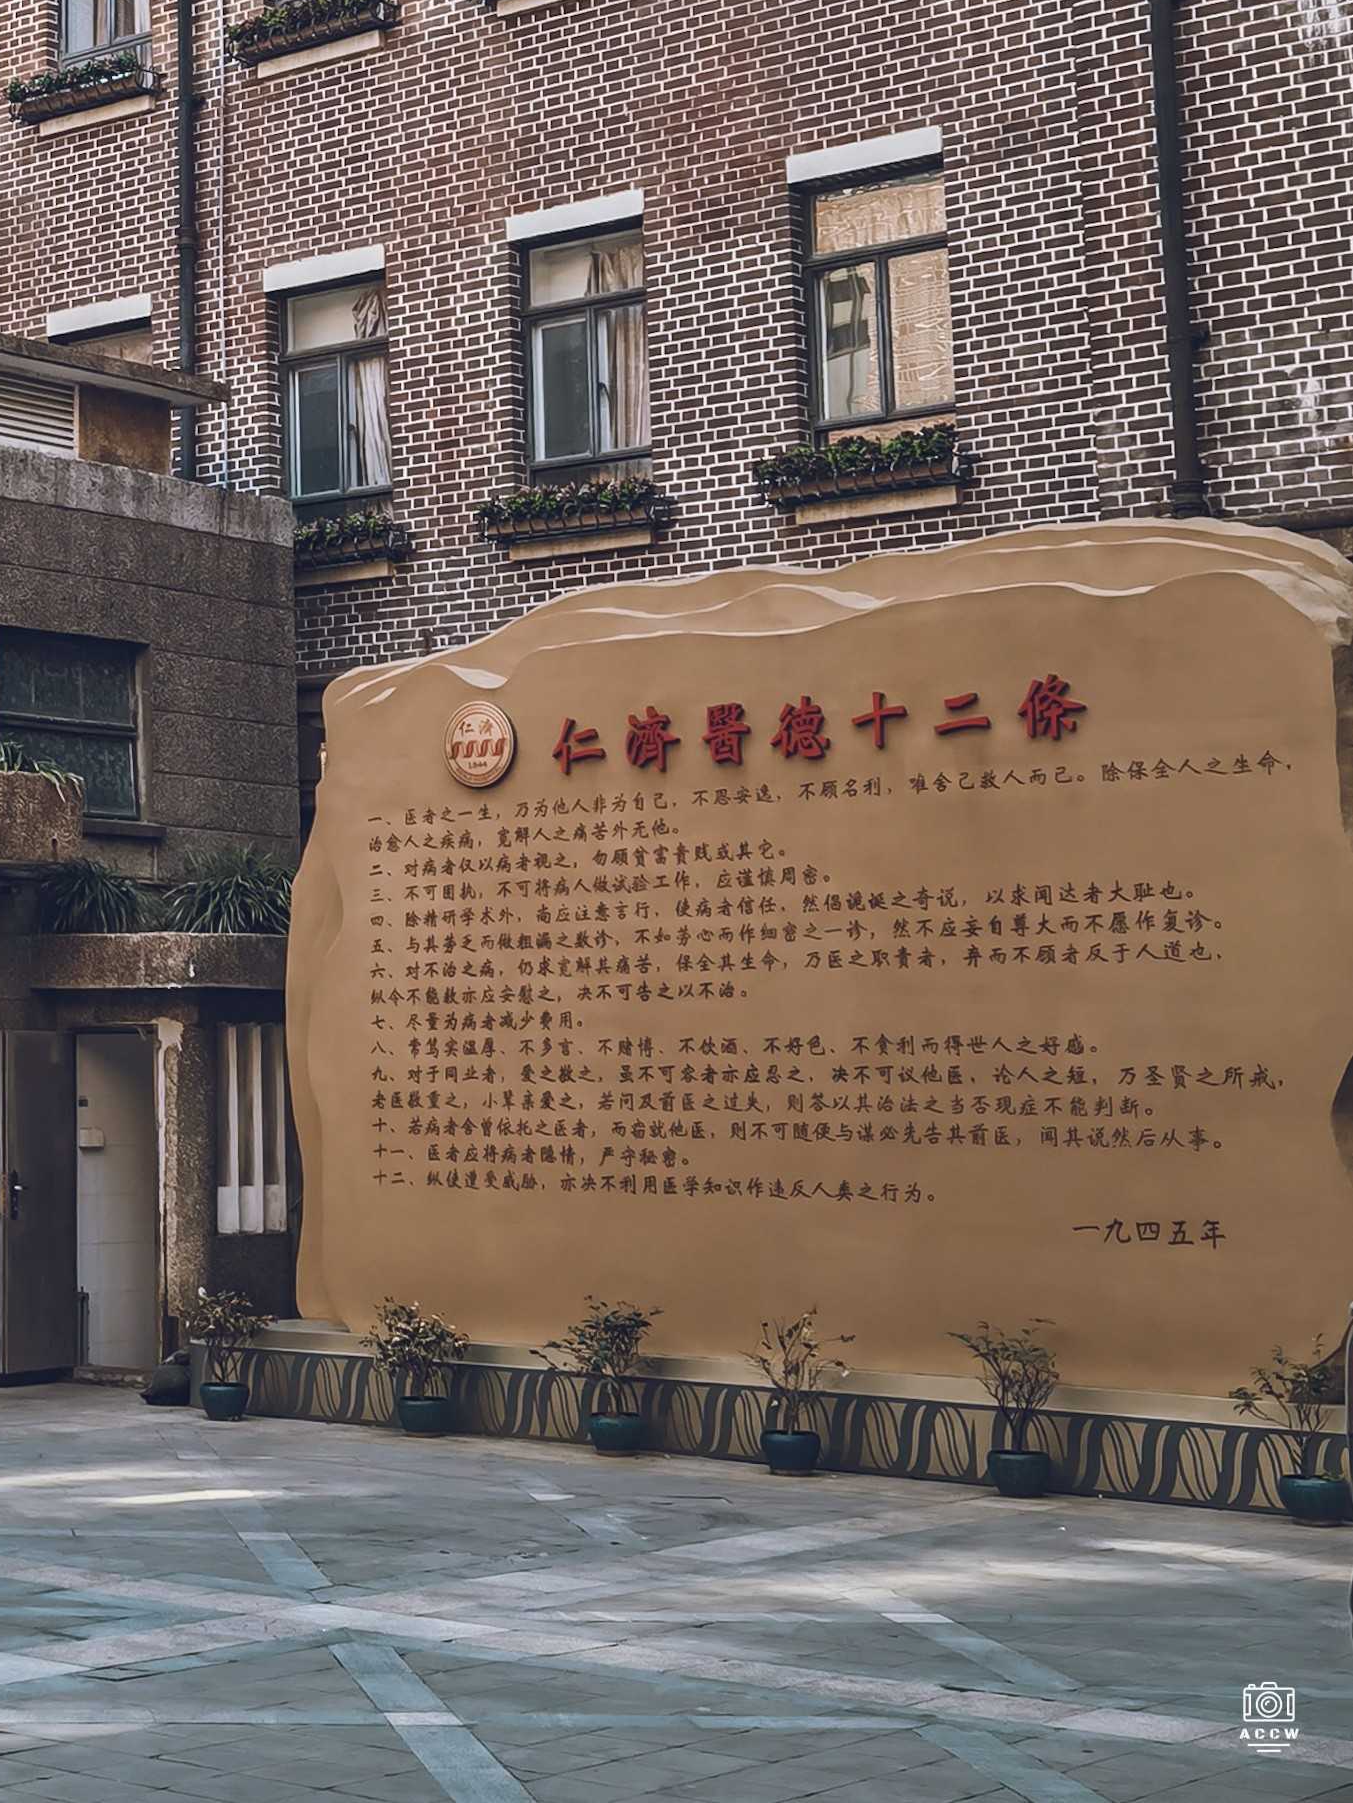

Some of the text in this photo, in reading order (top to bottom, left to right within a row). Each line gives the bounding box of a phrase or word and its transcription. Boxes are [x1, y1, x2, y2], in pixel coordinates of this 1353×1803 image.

[553, 674, 1087, 775] 仁濟醫德十二條
[1072, 1218, 1226, 1249] 一九四五年
